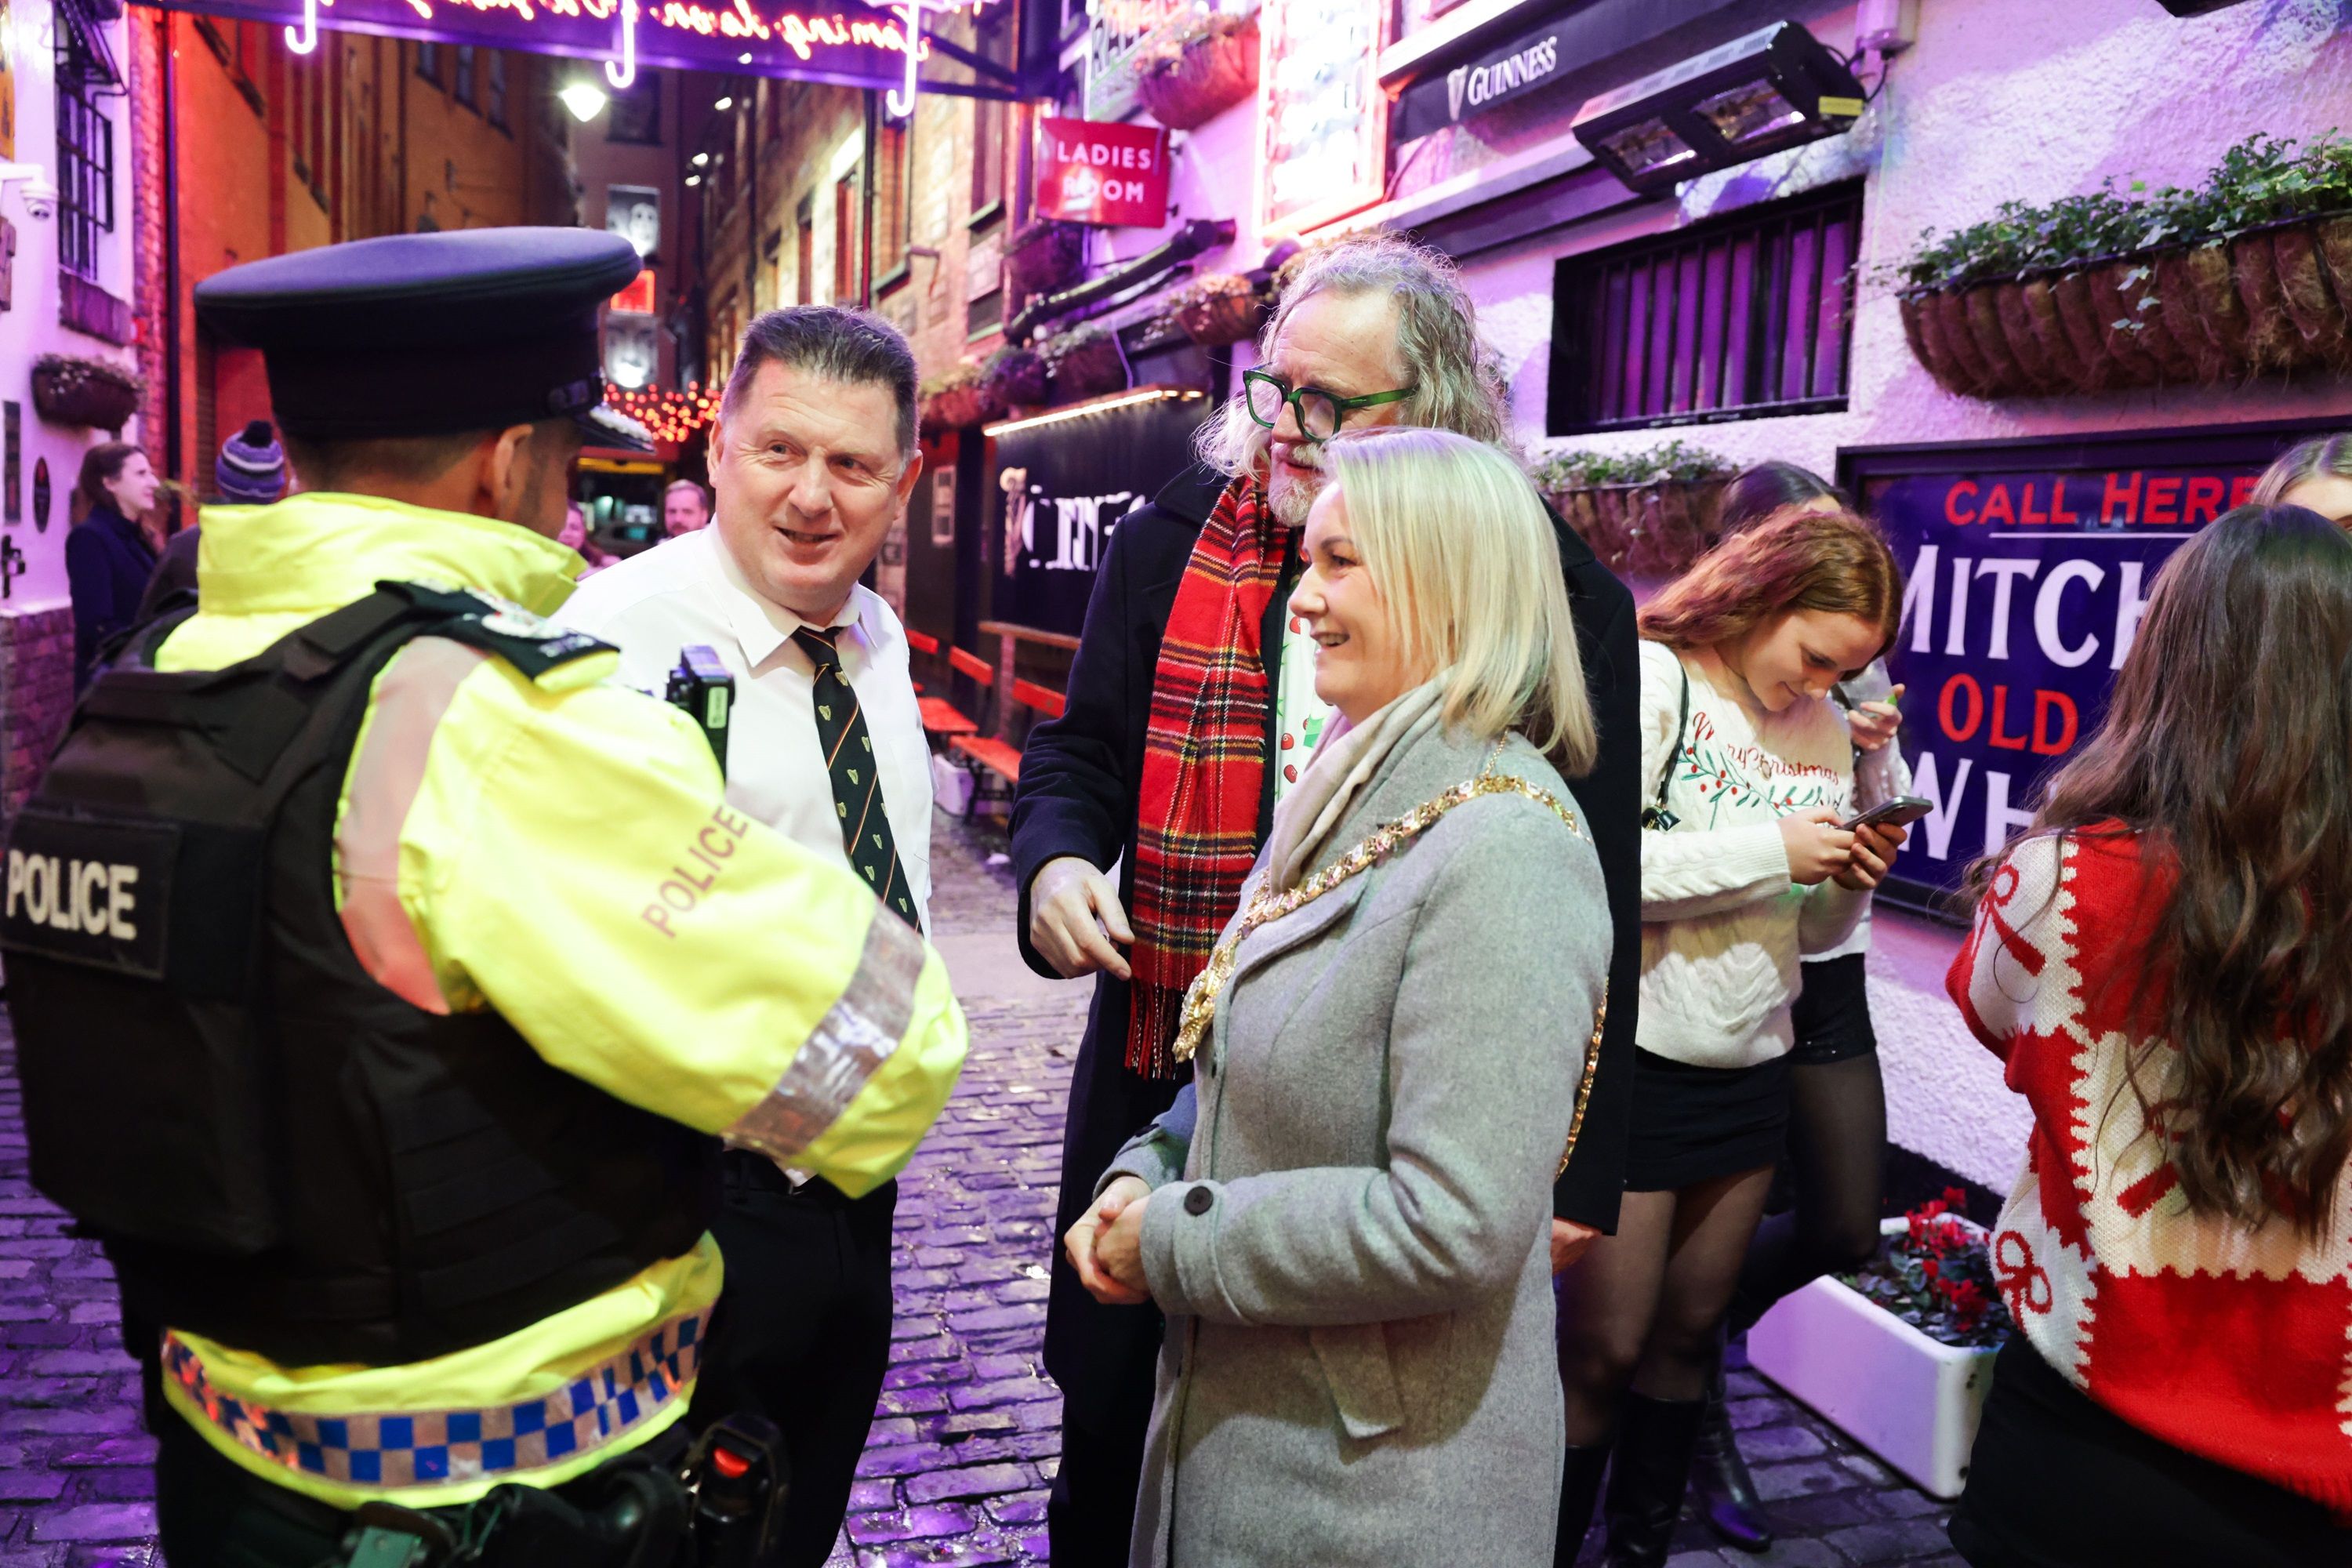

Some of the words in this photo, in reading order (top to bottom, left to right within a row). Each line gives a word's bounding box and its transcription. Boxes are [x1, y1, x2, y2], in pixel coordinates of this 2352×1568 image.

[1468, 36, 1558, 106] GUINNESS
[1057, 141, 1152, 169] LADIES
[1062, 175, 1145, 203] ROOM
[1944, 481, 2077, 527] CALL
[1937, 673, 2079, 756] OLD
[5, 848, 140, 941] POLICE
[641, 805, 749, 938] POLICE
